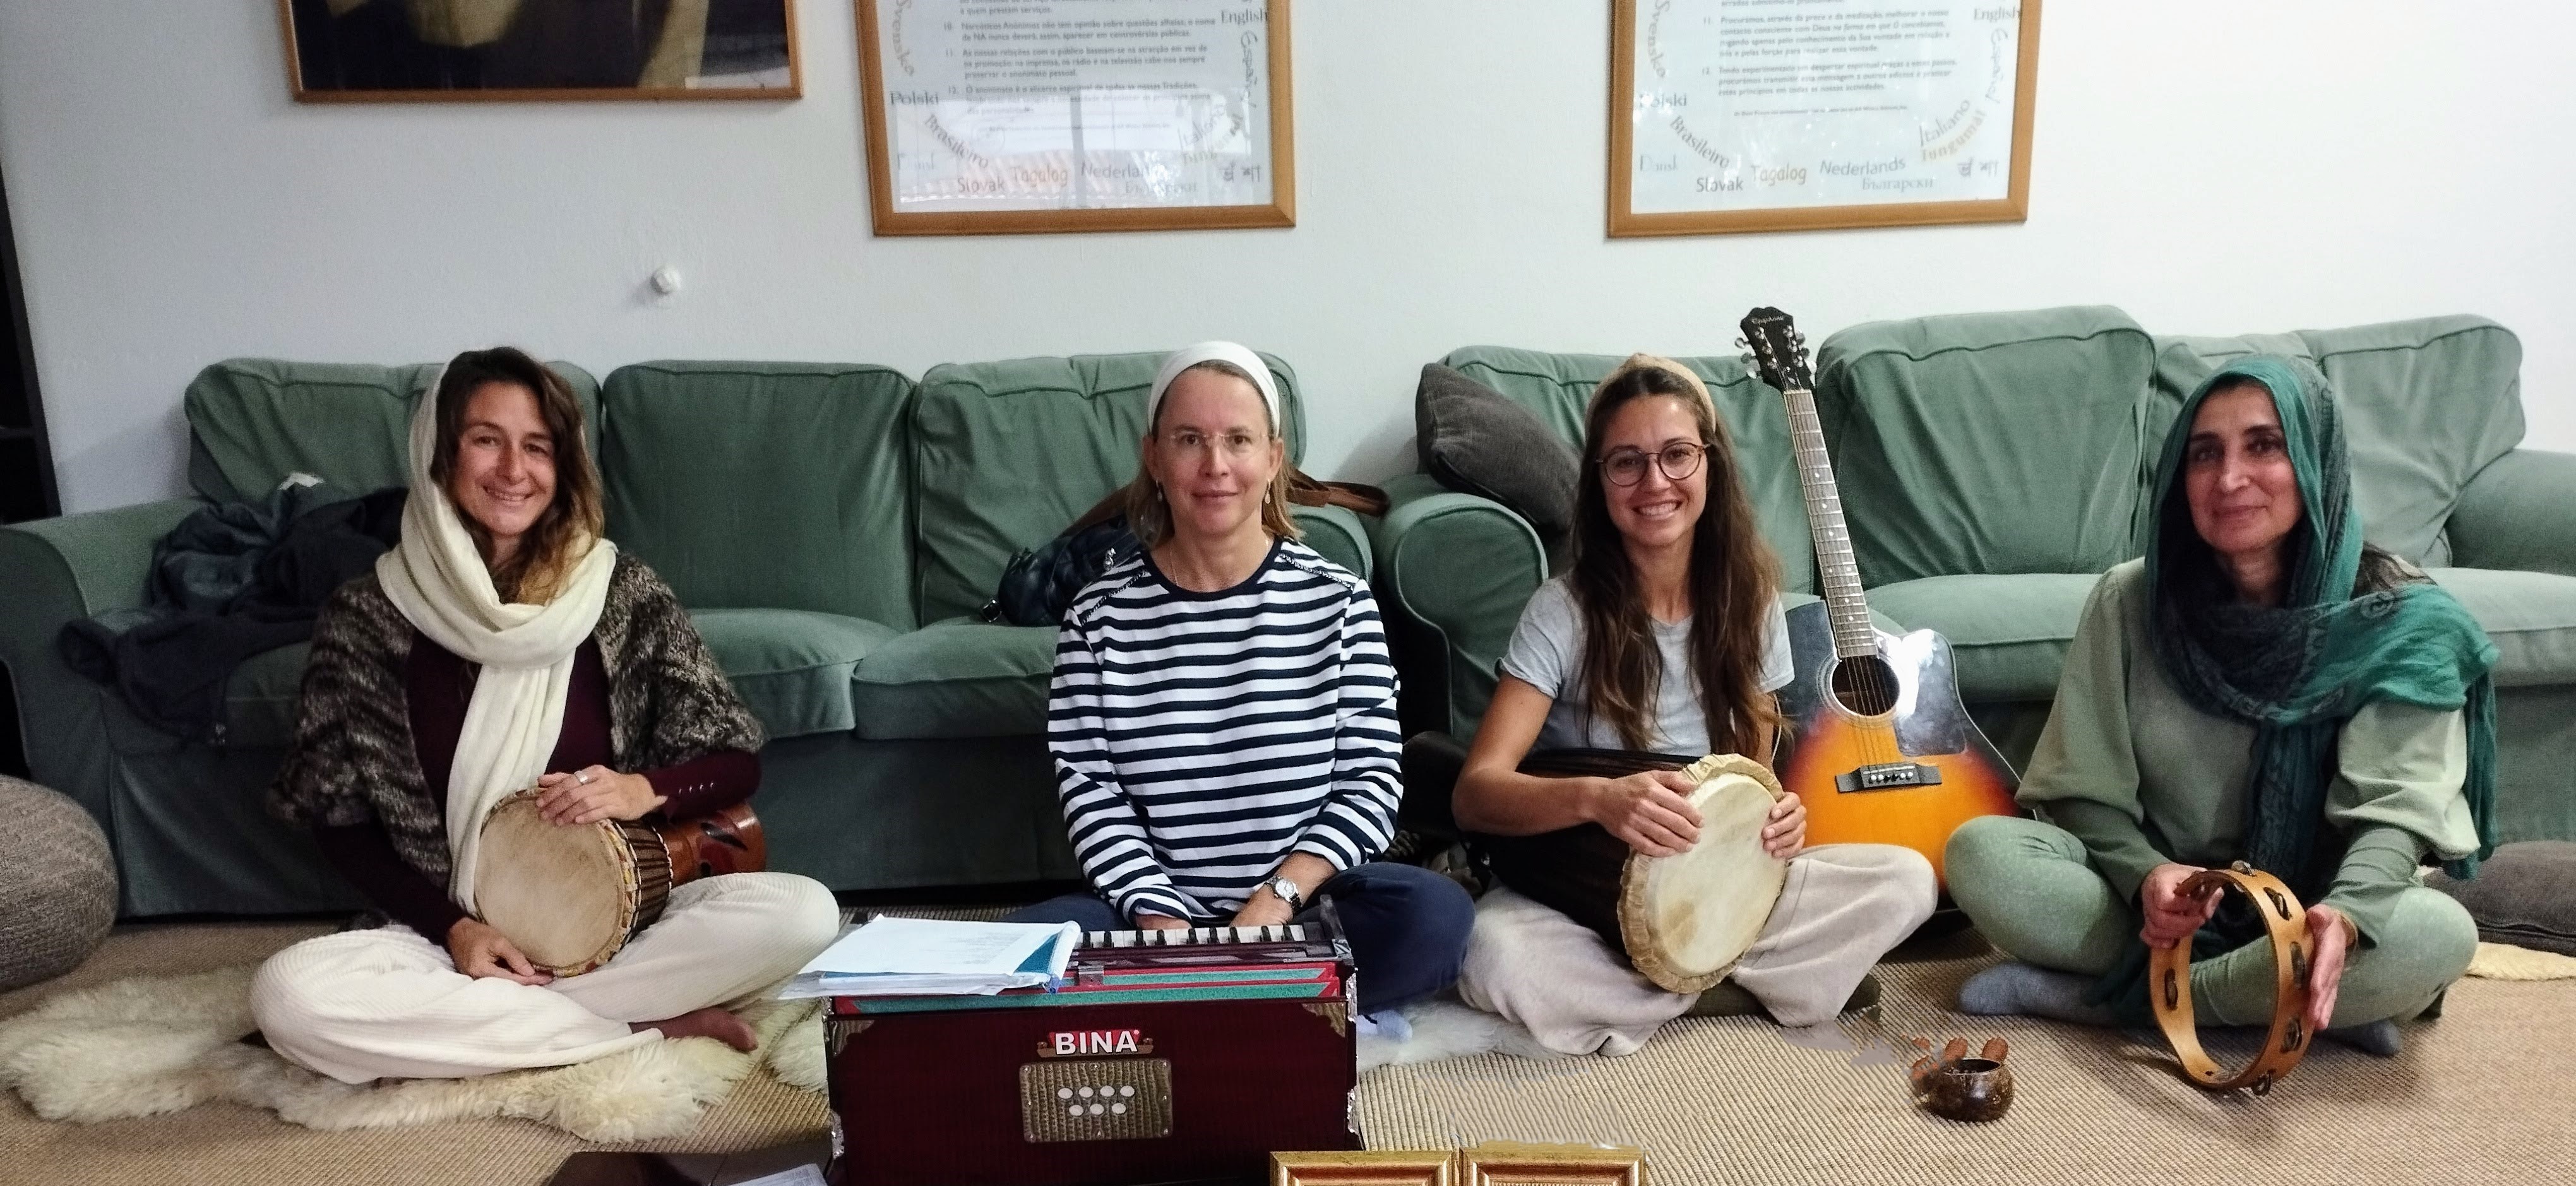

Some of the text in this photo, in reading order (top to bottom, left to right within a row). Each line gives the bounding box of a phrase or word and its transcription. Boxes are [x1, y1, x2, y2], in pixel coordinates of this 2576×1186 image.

[1221, 8, 1268, 25] English
[890, 91, 939, 106] Polski
[1670, 115, 1729, 169] Brasileiro
[1011, 165, 1069, 187] Tagalog
[1750, 162, 1807, 187] Tagalog
[1820, 157, 1906, 177] Nederlands
[957, 177, 1006, 193] Slovak
[1696, 176, 1744, 193] Slovak
[1055, 1031, 1138, 1055] BINA
